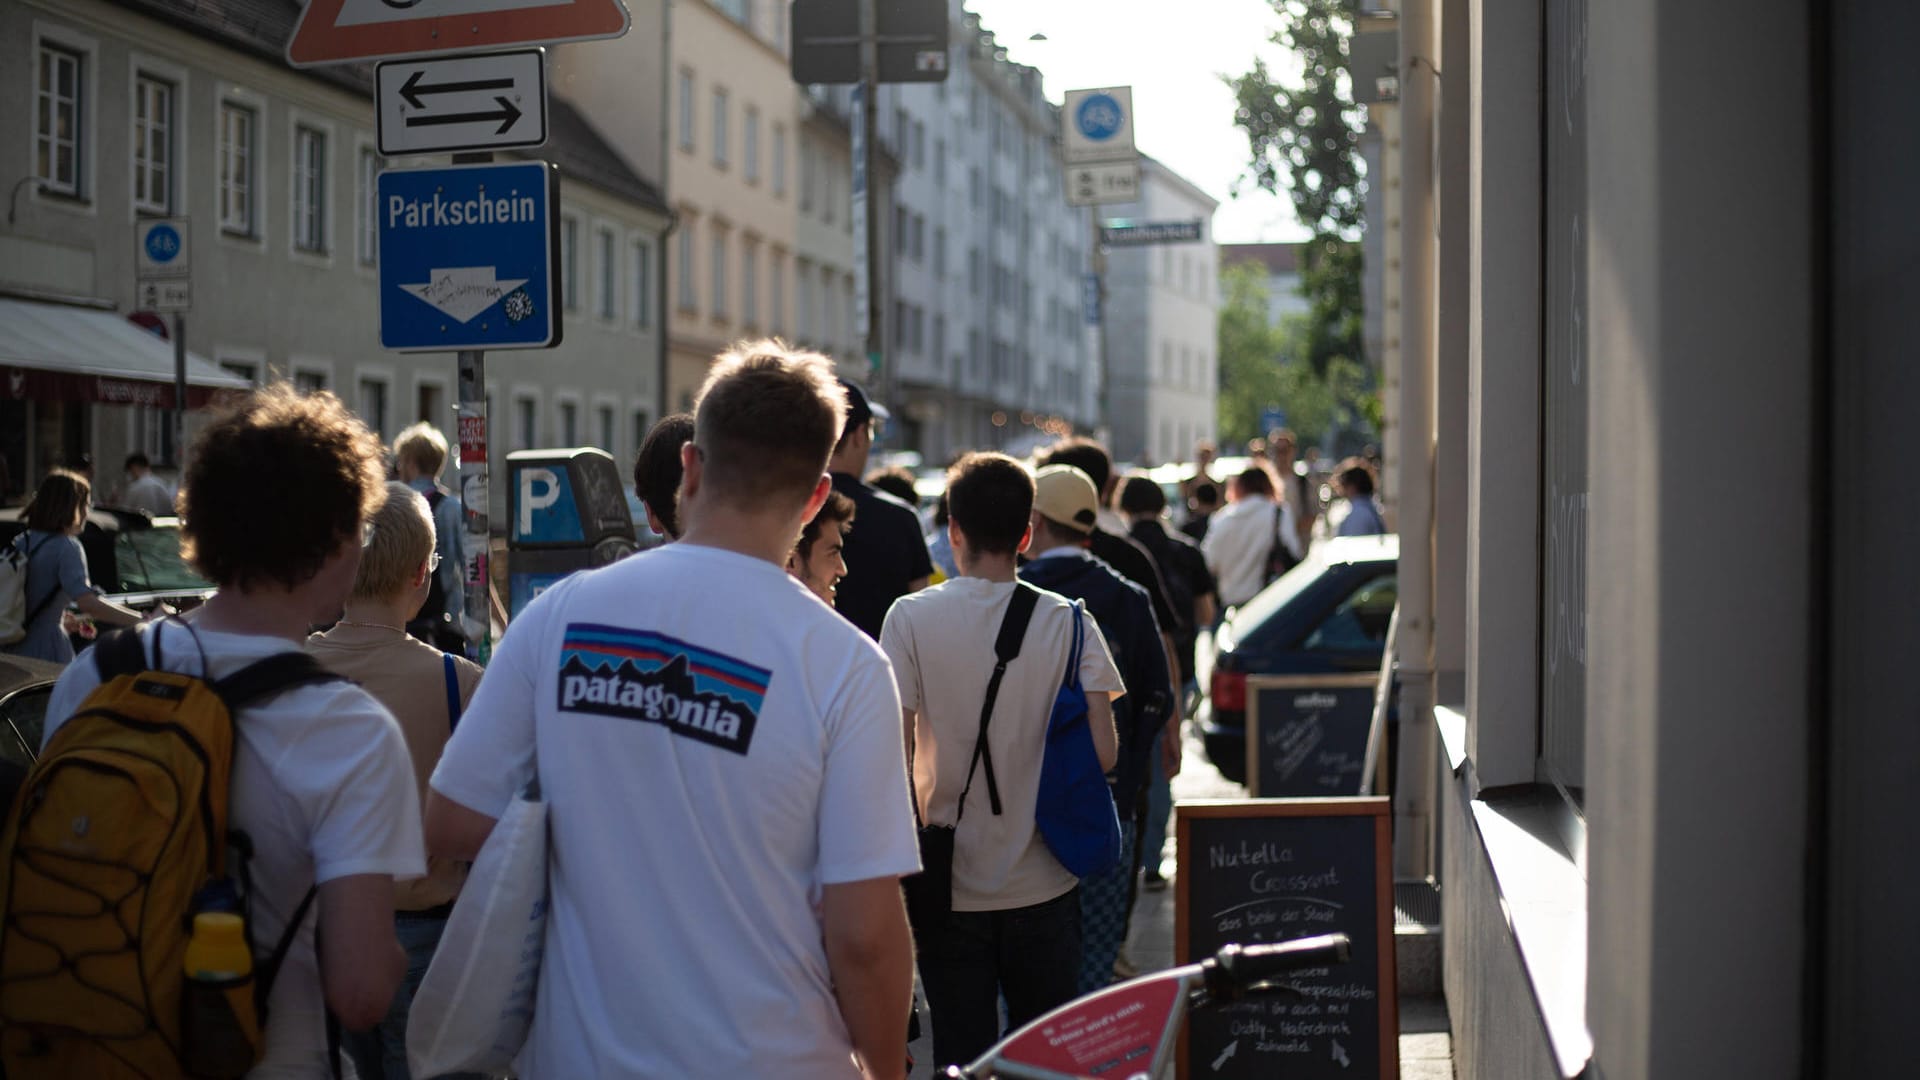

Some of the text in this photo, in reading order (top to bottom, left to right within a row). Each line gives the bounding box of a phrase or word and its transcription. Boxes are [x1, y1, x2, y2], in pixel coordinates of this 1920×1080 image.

[389, 189, 536, 227] Parkschein
[520, 467, 561, 536] P
[562, 675, 741, 739] patagonia
[1209, 839, 1297, 870] Nutella
